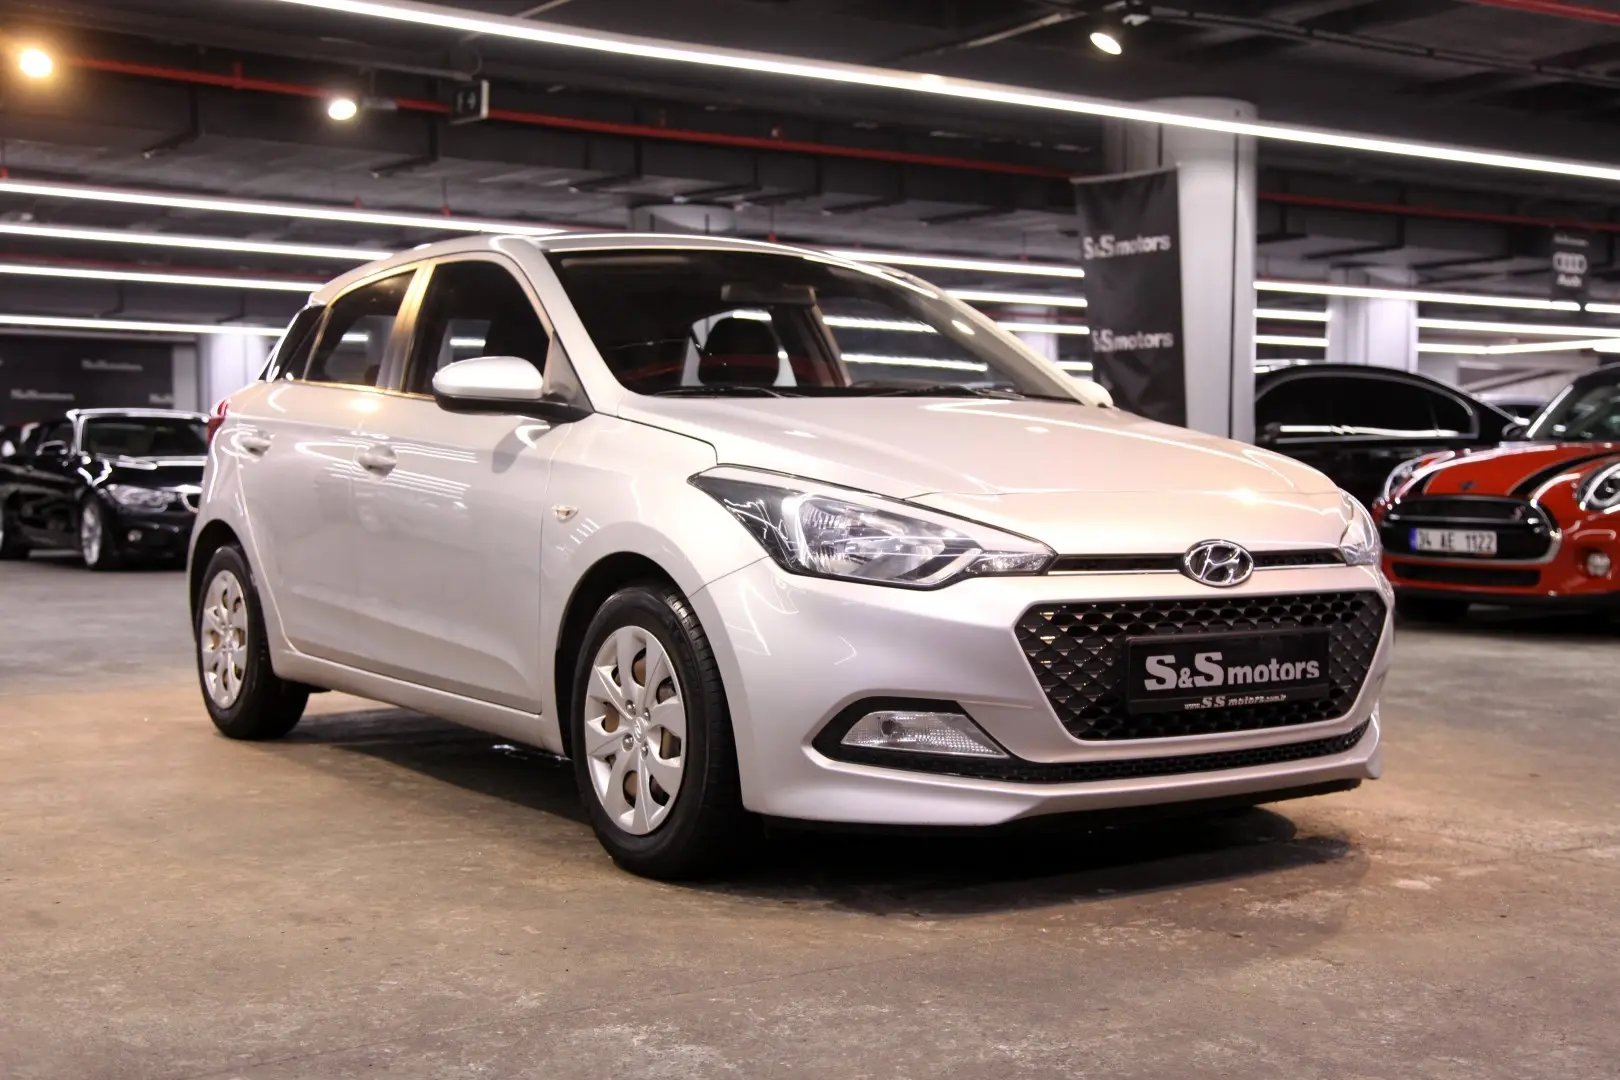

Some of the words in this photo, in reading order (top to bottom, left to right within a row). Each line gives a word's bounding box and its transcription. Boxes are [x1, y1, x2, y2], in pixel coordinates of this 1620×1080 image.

[1115, 235, 1171, 256] motors
[1114, 331, 1174, 350] motors
[1465, 534, 1494, 554] 1122
[1144, 652, 1224, 690] S&S
[1227, 658, 1320, 685] motors
